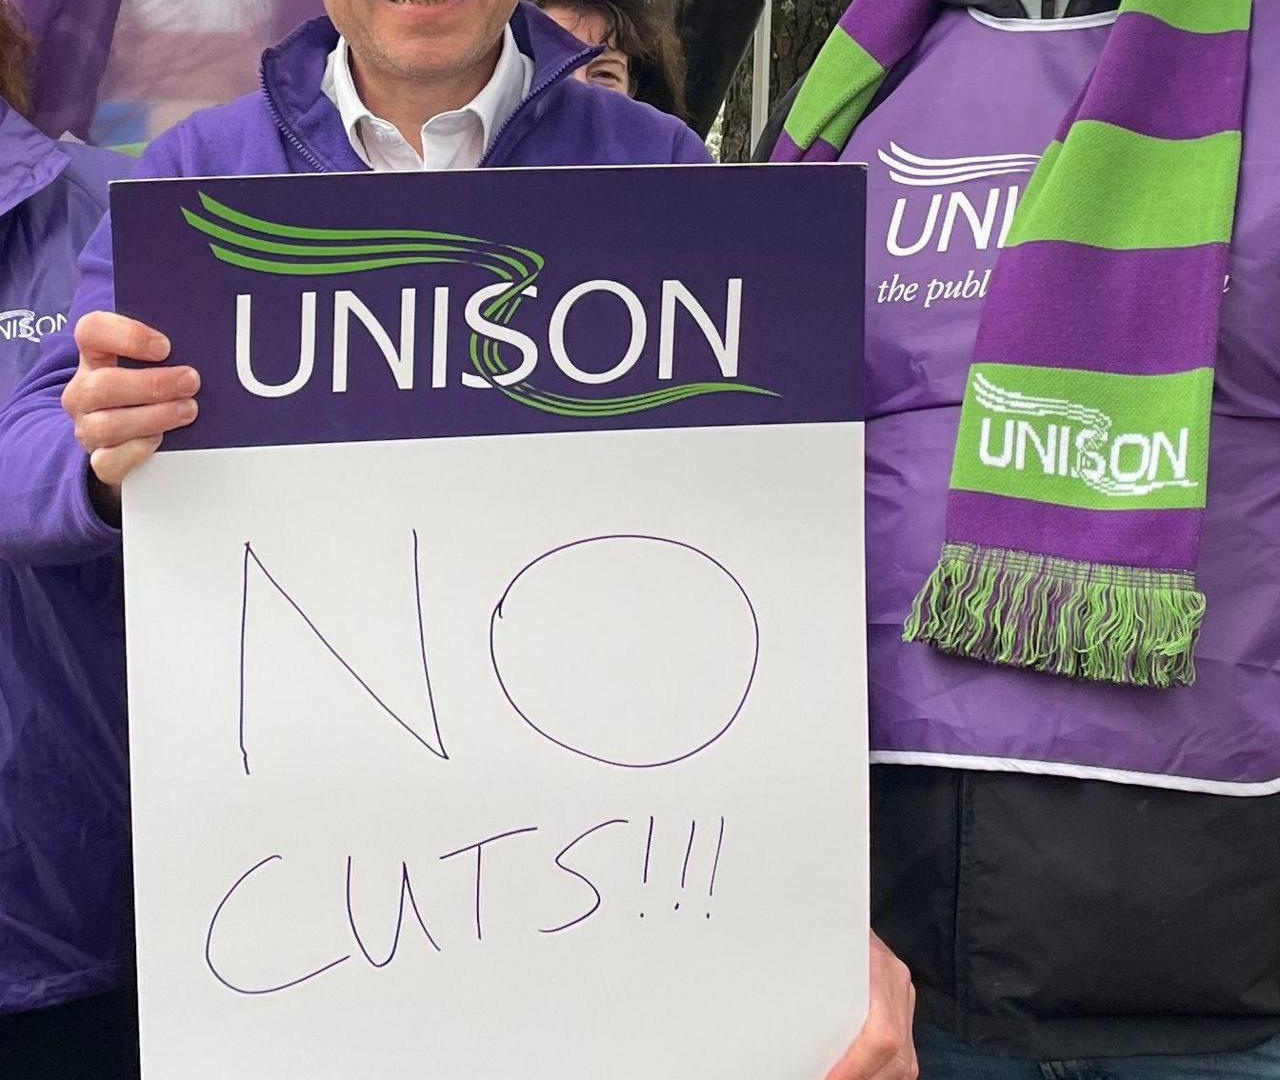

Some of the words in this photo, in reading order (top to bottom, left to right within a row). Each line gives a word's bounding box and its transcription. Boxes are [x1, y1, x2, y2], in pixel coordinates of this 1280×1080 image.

[235, 277, 743, 398] UNISON
[877, 275, 918, 303] the
[978, 416, 1189, 483] UNISON
[239, 527, 760, 777] NO
[205, 815, 726, 995] CUTS!!!
